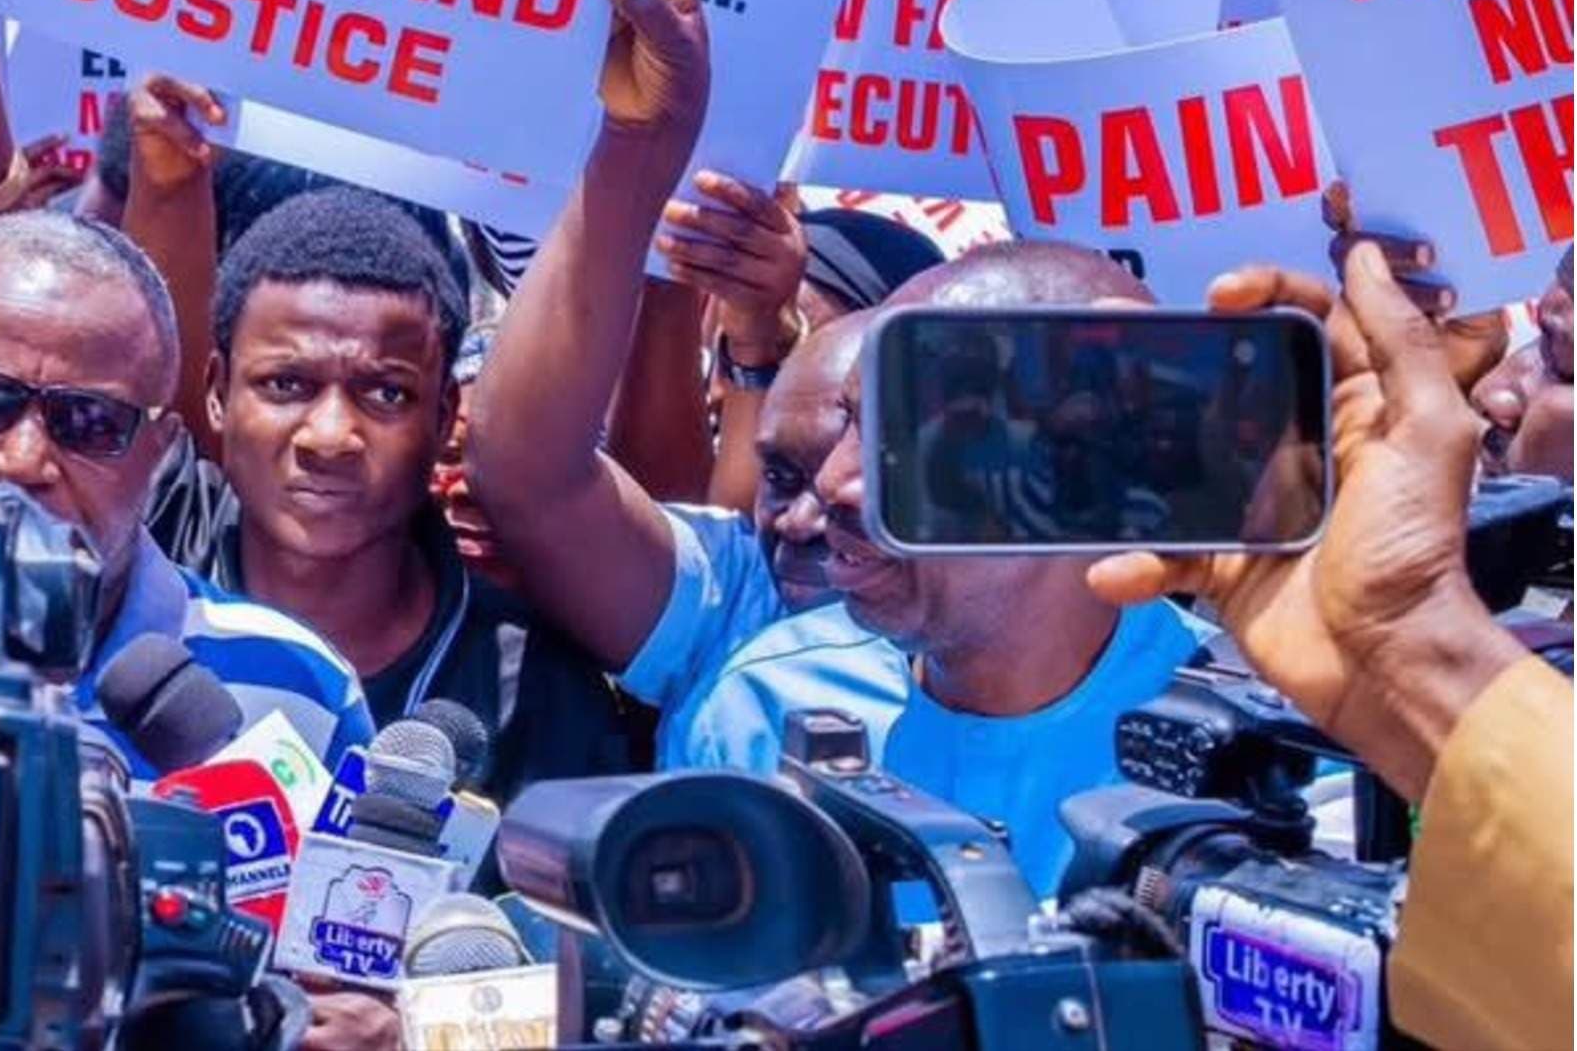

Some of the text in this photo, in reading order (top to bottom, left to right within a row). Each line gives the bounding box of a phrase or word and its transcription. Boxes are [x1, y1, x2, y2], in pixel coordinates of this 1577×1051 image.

[1013, 75, 1319, 229] PAIN
[326, 925, 397, 960] Liberty
[338, 950, 373, 973] TV
[1226, 939, 1336, 1022] Liberty
[1254, 996, 1303, 1040] TV
